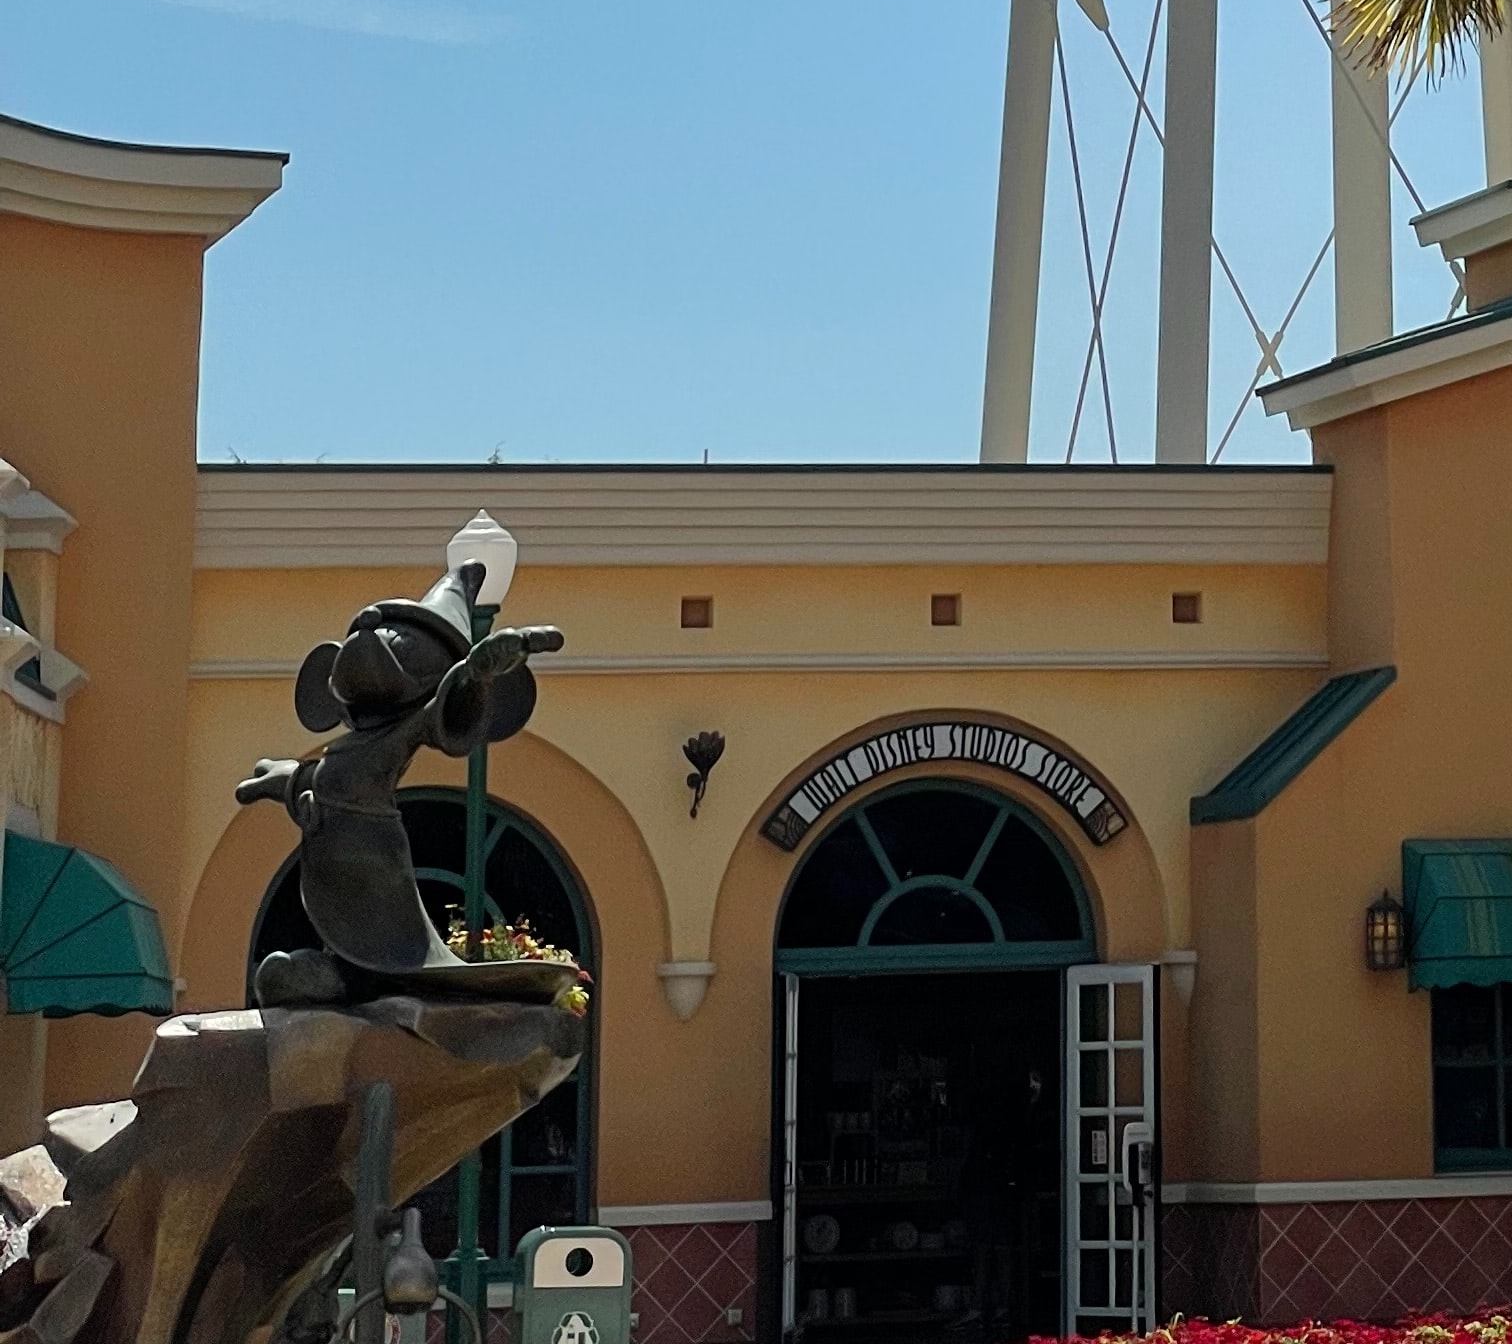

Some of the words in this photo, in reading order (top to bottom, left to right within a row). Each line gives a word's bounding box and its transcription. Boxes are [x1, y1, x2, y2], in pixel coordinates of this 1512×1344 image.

[801, 752, 859, 811] WALT
[862, 725, 935, 774] DISNEY
[949, 724, 1034, 771] STUDIOS
[1034, 750, 1098, 809] STORE
